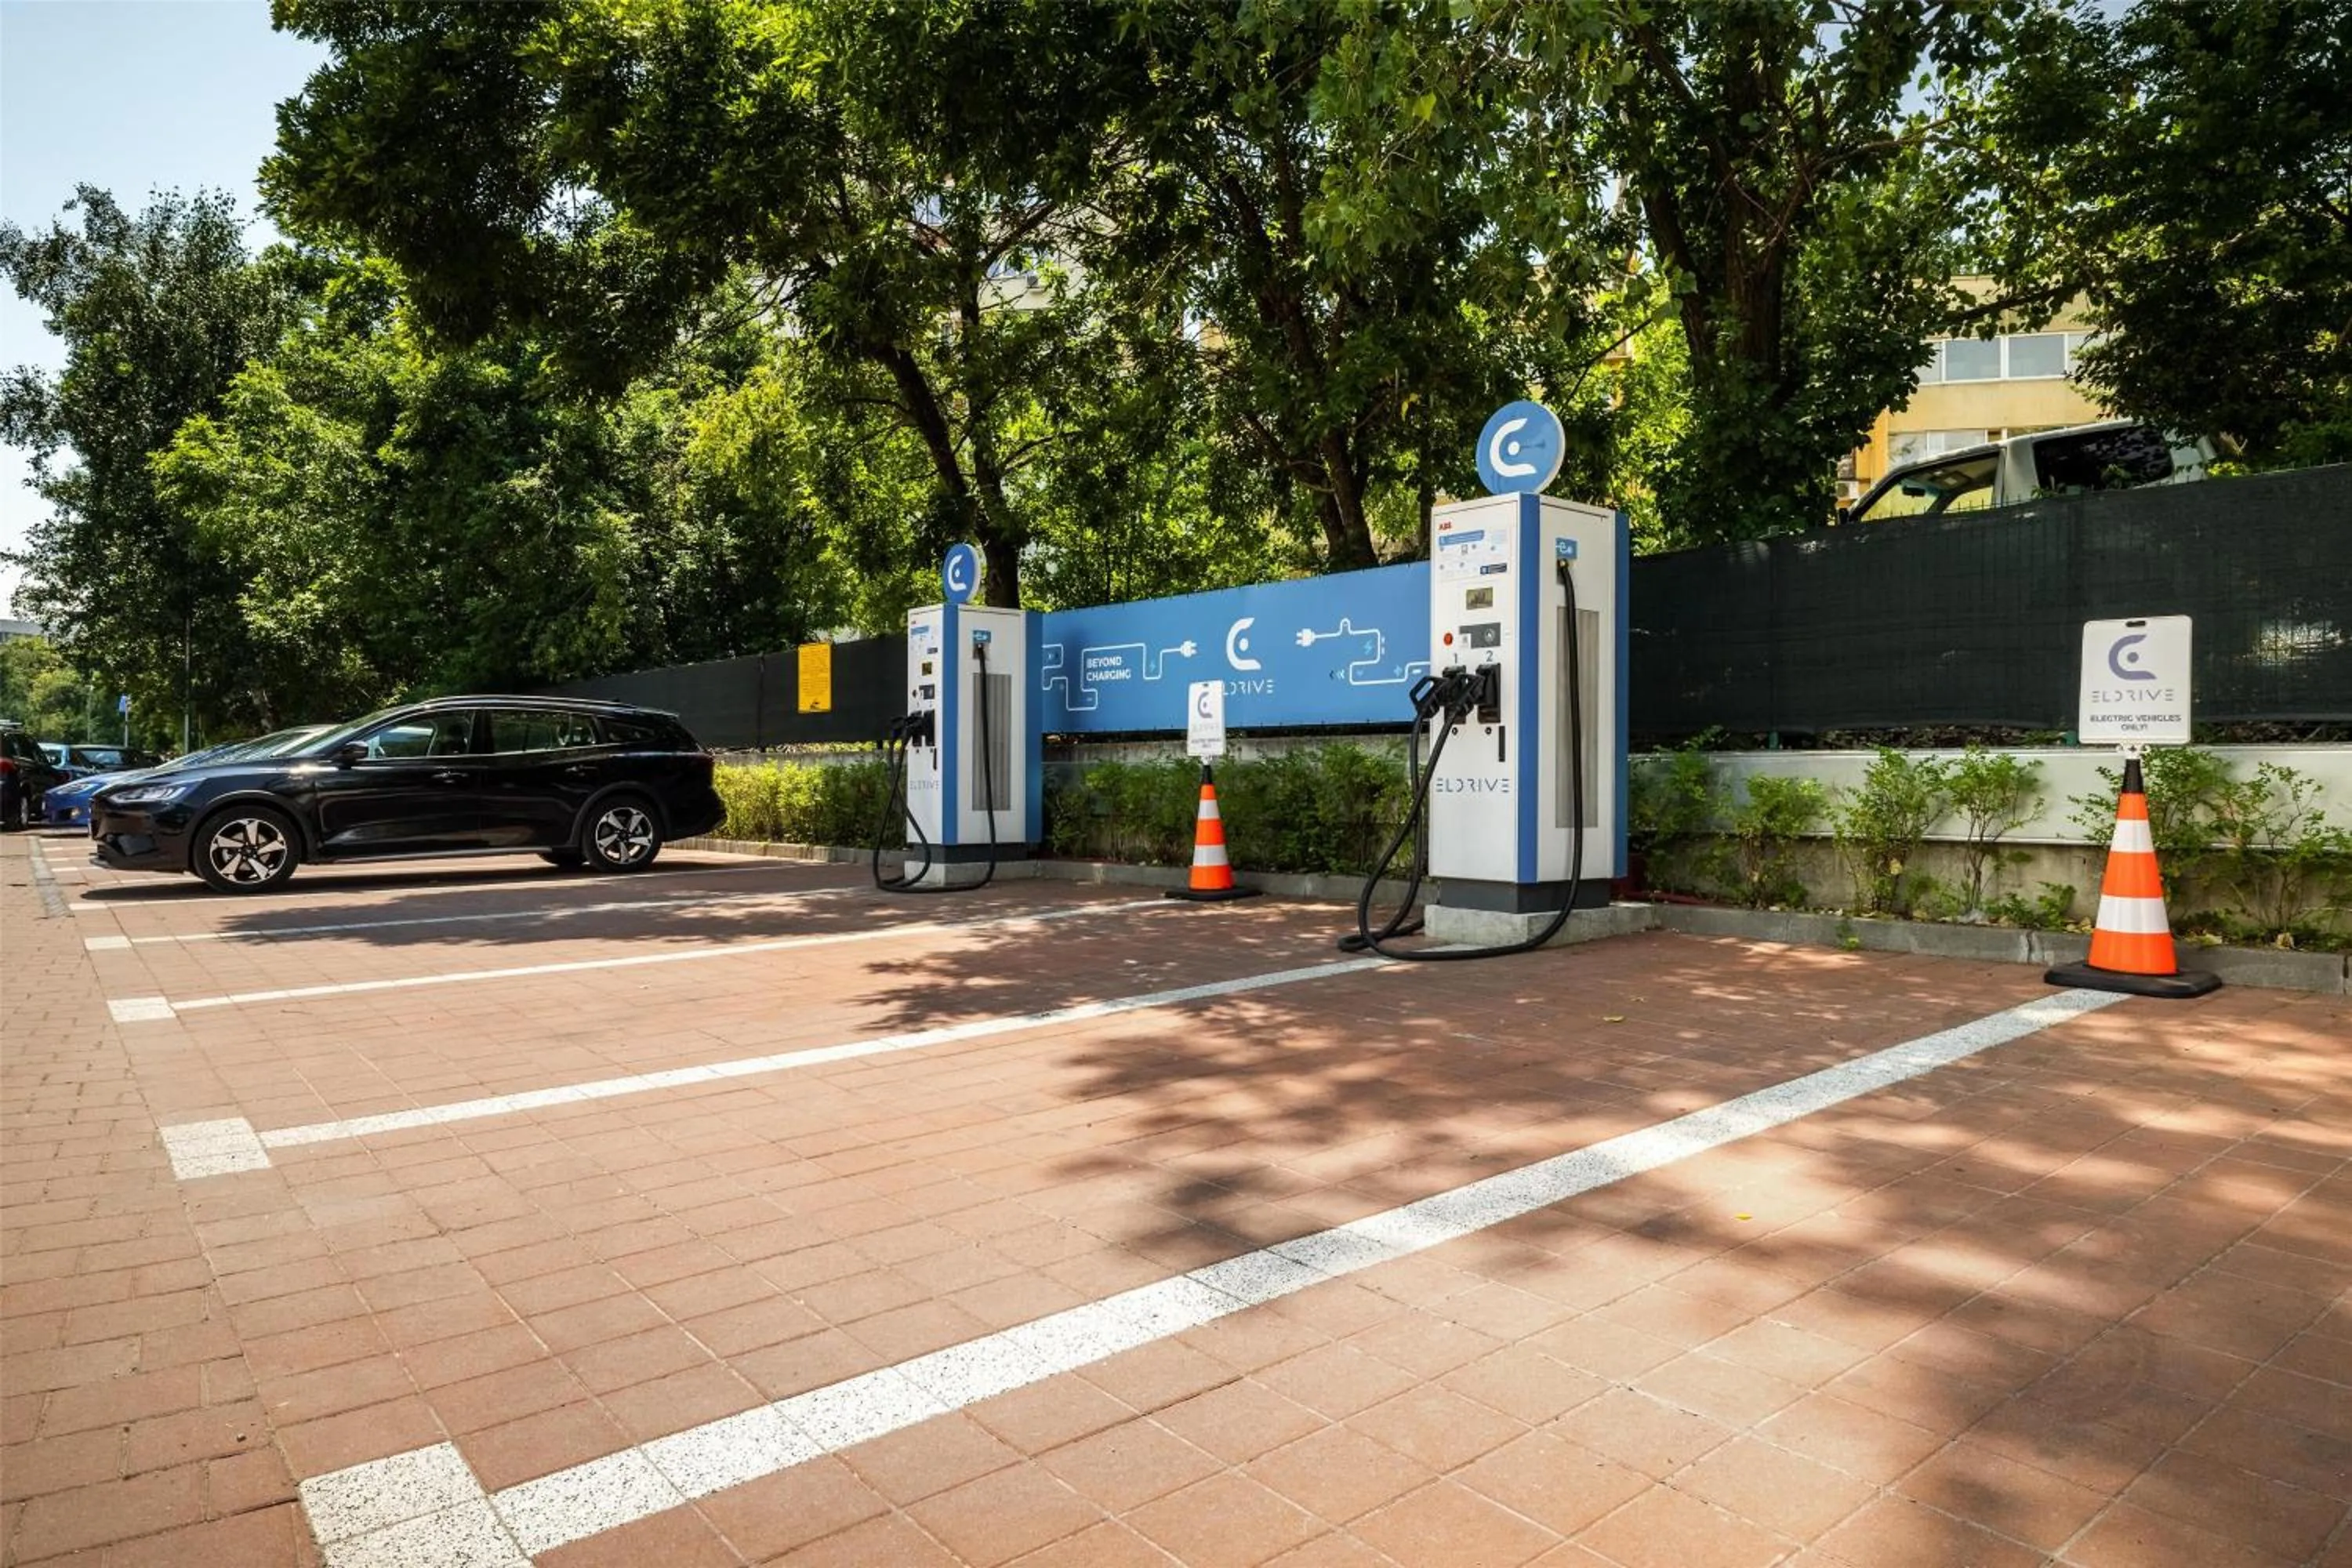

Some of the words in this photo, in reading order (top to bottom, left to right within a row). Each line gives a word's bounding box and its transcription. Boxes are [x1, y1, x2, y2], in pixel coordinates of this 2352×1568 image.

[1453, 653, 1458, 664] 1
[1486, 650, 1494, 662] 2
[1086, 656, 1122, 669] BEYOND
[1086, 669, 1131, 681] CHARGING
[1221, 679, 1274, 695] LDRIVE
[2091, 688, 2175, 703] ELDRIVE
[2089, 714, 2133, 723] ELECTRIC
[1436, 778, 1510, 793] ELDRIVE
